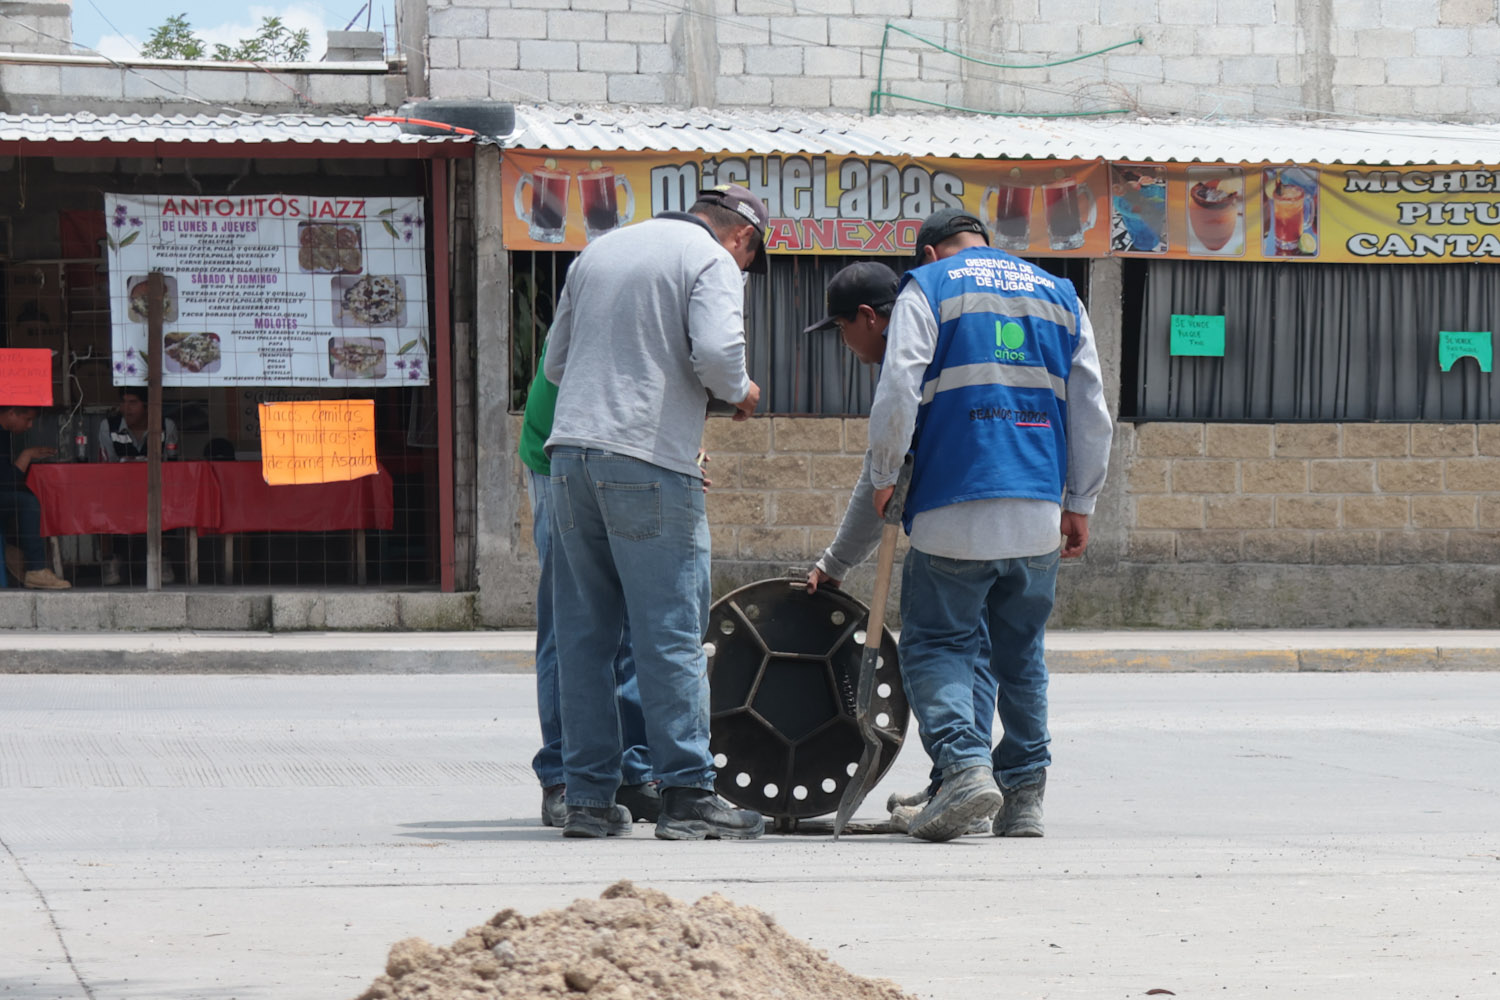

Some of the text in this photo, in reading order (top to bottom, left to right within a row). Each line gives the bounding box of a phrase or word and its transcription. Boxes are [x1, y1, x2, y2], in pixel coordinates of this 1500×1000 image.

[162, 198, 367, 218] ANTOJITOS JAZZ
[162, 221, 257, 232] DE LUNES A JUEVES
[767, 219, 925, 251] ANEXO
[965, 258, 1034, 274] GERENCIA DE
[229, 274, 234, 284] Y
[237, 274, 277, 284] DOMINGO
[995, 269, 1002, 279] Y
[976, 276, 1034, 292] DE FUGAS
[255, 318, 297, 329] MOLOTES
[995, 348, 1025, 361] años
[969, 407, 1012, 420] SEAMOS
[268, 448, 373, 469] de carne Asada
